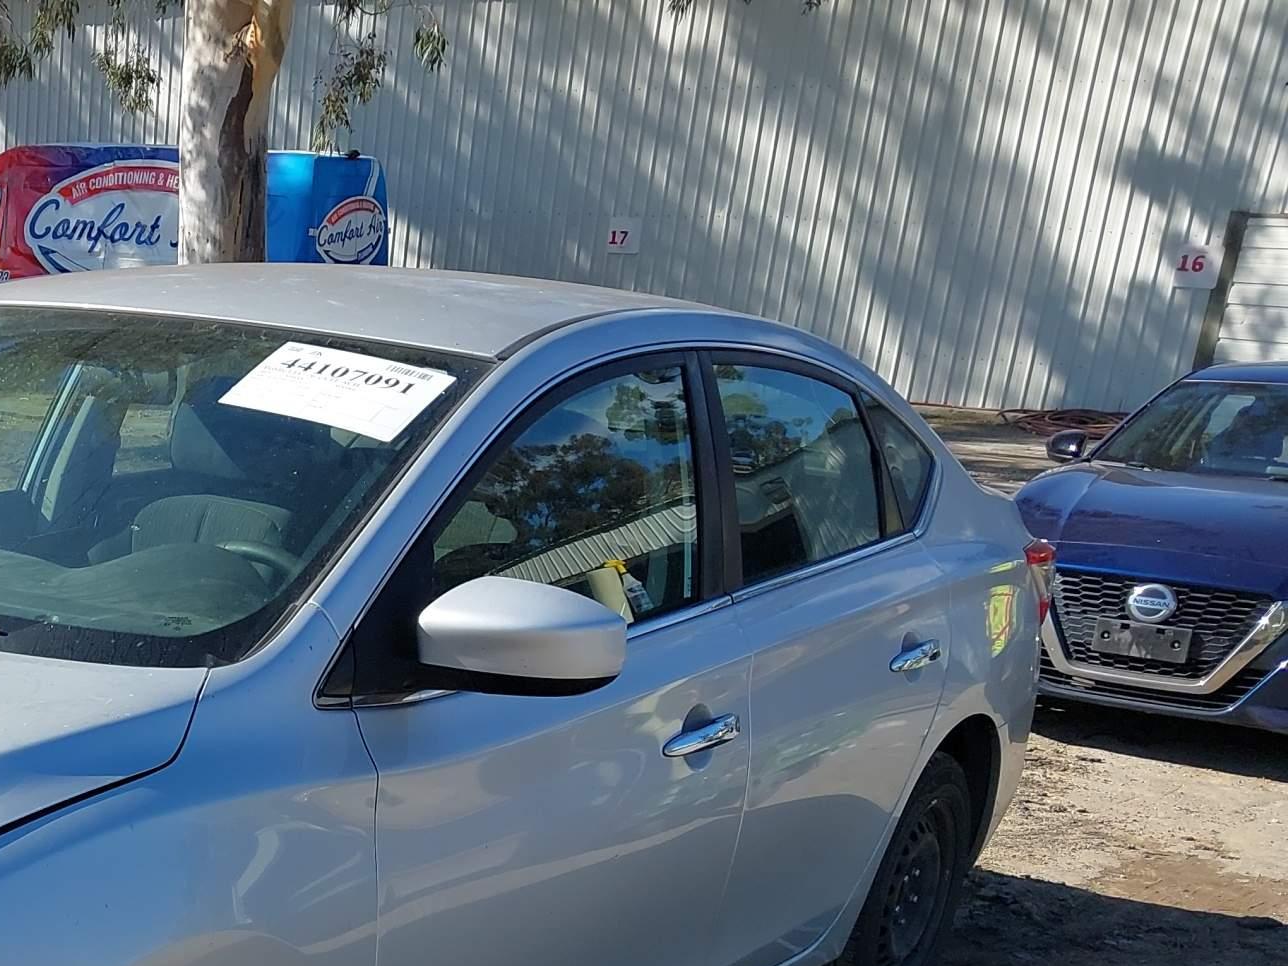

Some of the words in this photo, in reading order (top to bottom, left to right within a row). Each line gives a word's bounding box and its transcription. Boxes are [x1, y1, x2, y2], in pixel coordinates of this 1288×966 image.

[72, 182, 88, 199] AIR
[89, 171, 156, 190] CONDITIONING
[157, 174, 165, 186] &
[29, 198, 162, 254] Comfort
[318, 219, 364, 248] Comfort
[608, 230, 629, 245] 17
[1176, 254, 1206, 272] 16
[280, 358, 416, 394] 44107091
[1134, 597, 1170, 608] NISSAN
